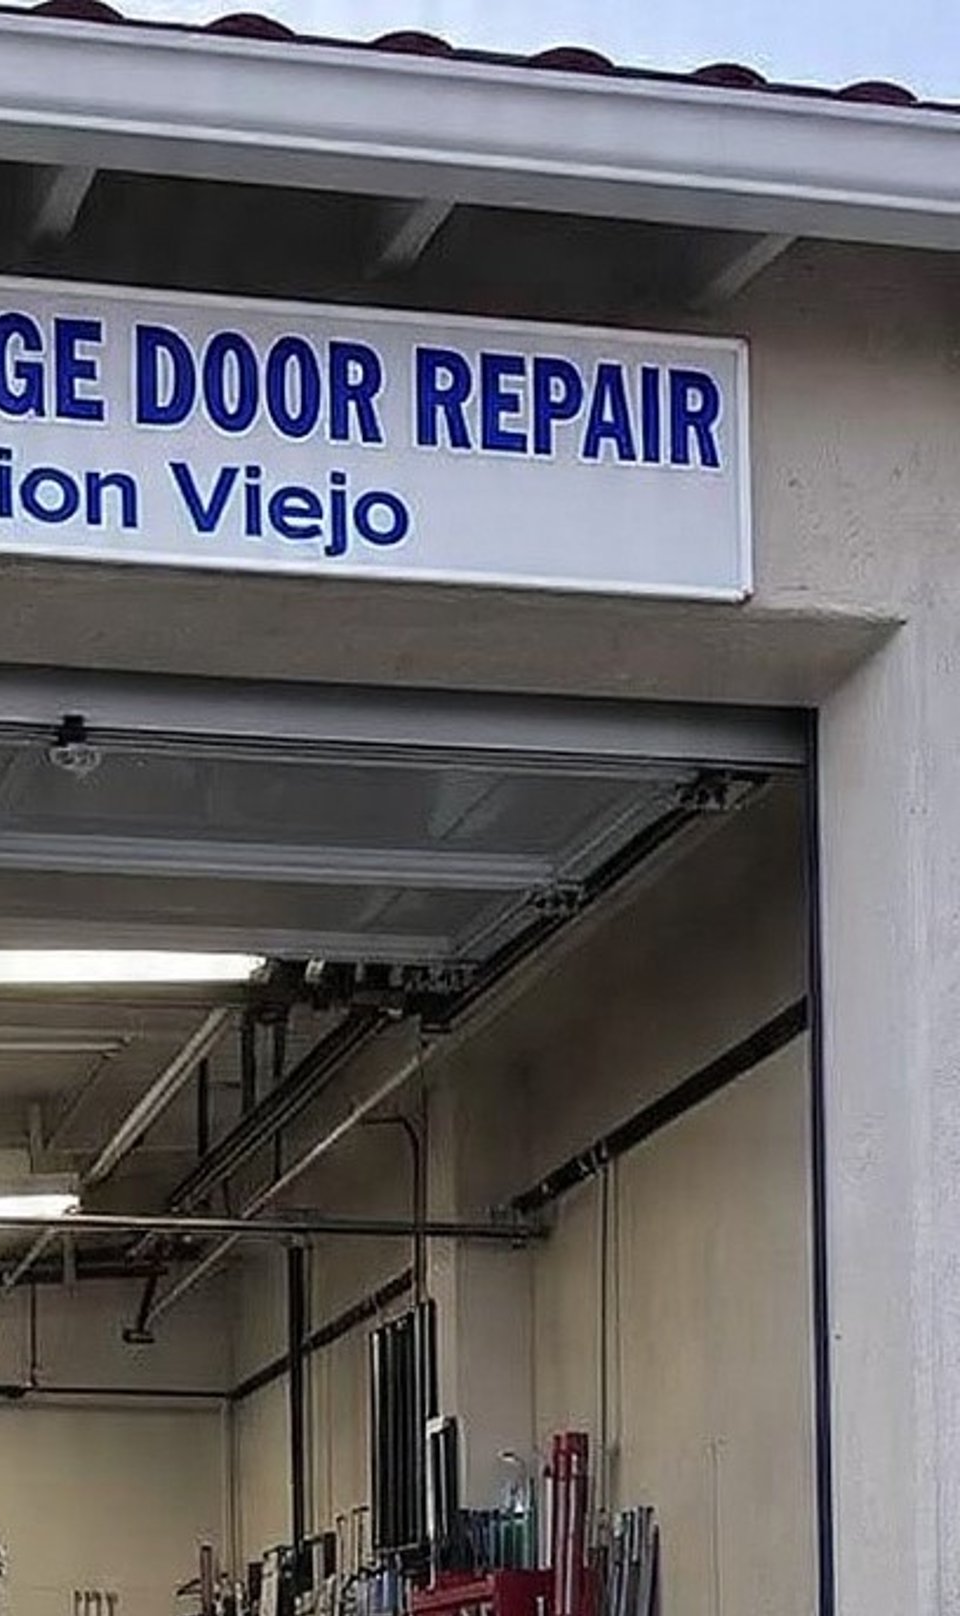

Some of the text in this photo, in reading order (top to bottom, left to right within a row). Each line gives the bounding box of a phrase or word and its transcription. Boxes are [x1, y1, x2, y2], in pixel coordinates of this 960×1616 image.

[137, 323, 383, 444] DOOR
[416, 348, 720, 467] REPAIR
[170, 461, 410, 557] Viejo
